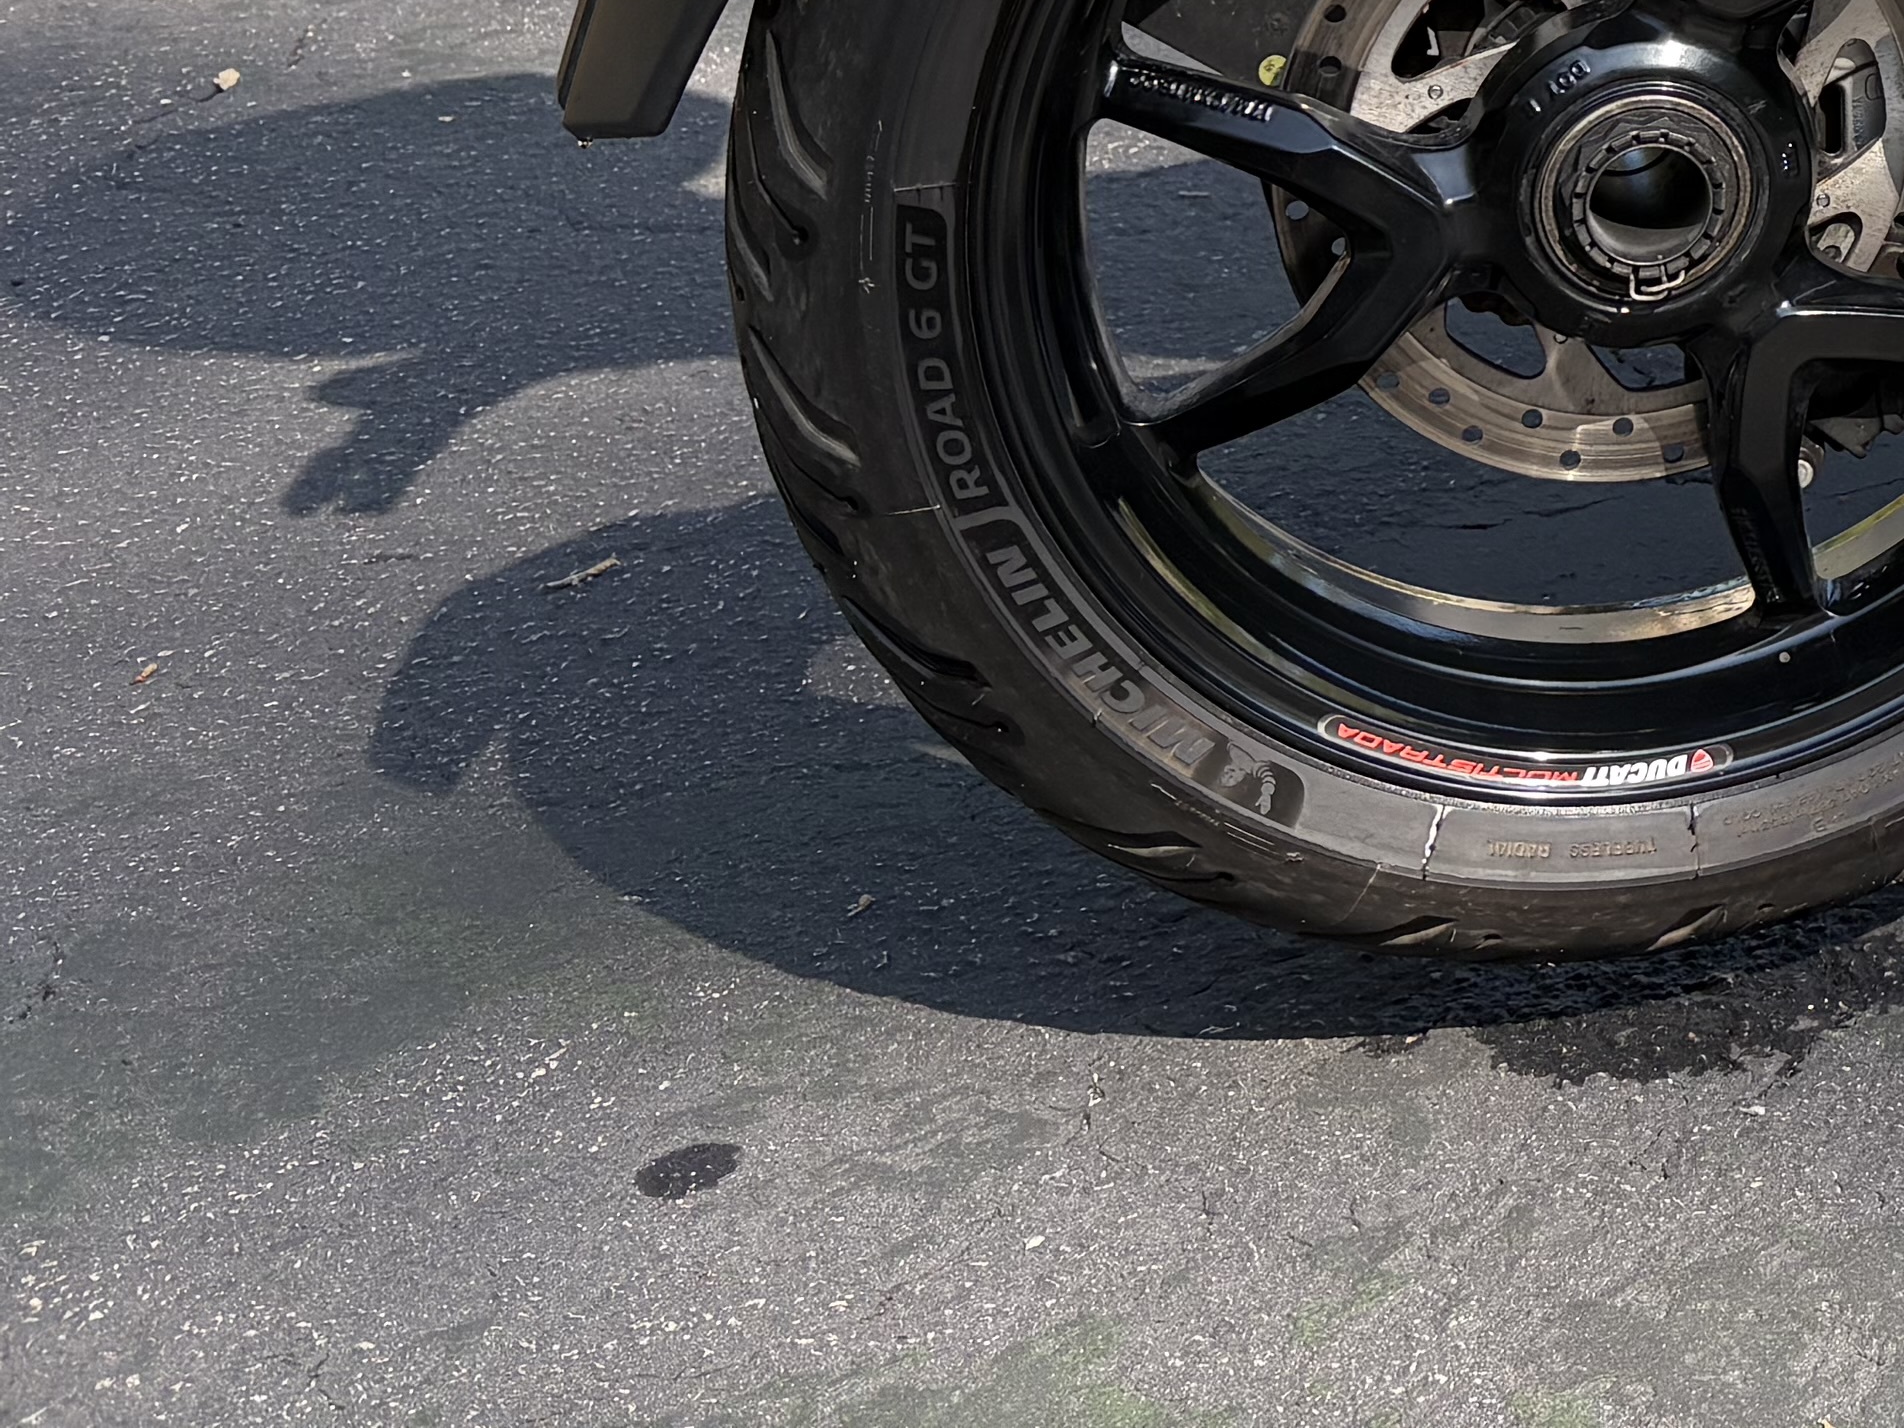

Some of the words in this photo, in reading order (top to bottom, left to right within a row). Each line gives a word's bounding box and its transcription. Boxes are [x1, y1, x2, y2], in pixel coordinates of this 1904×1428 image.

[905, 222, 938, 292] GT
[908, 309, 942, 339] 6
[917, 356, 989, 500] ROAD
[979, 547, 1216, 776] MICHELIN
[1337, 721, 1584, 784] MULTISTRADA
[1582, 753, 1687, 788] DUCATI
